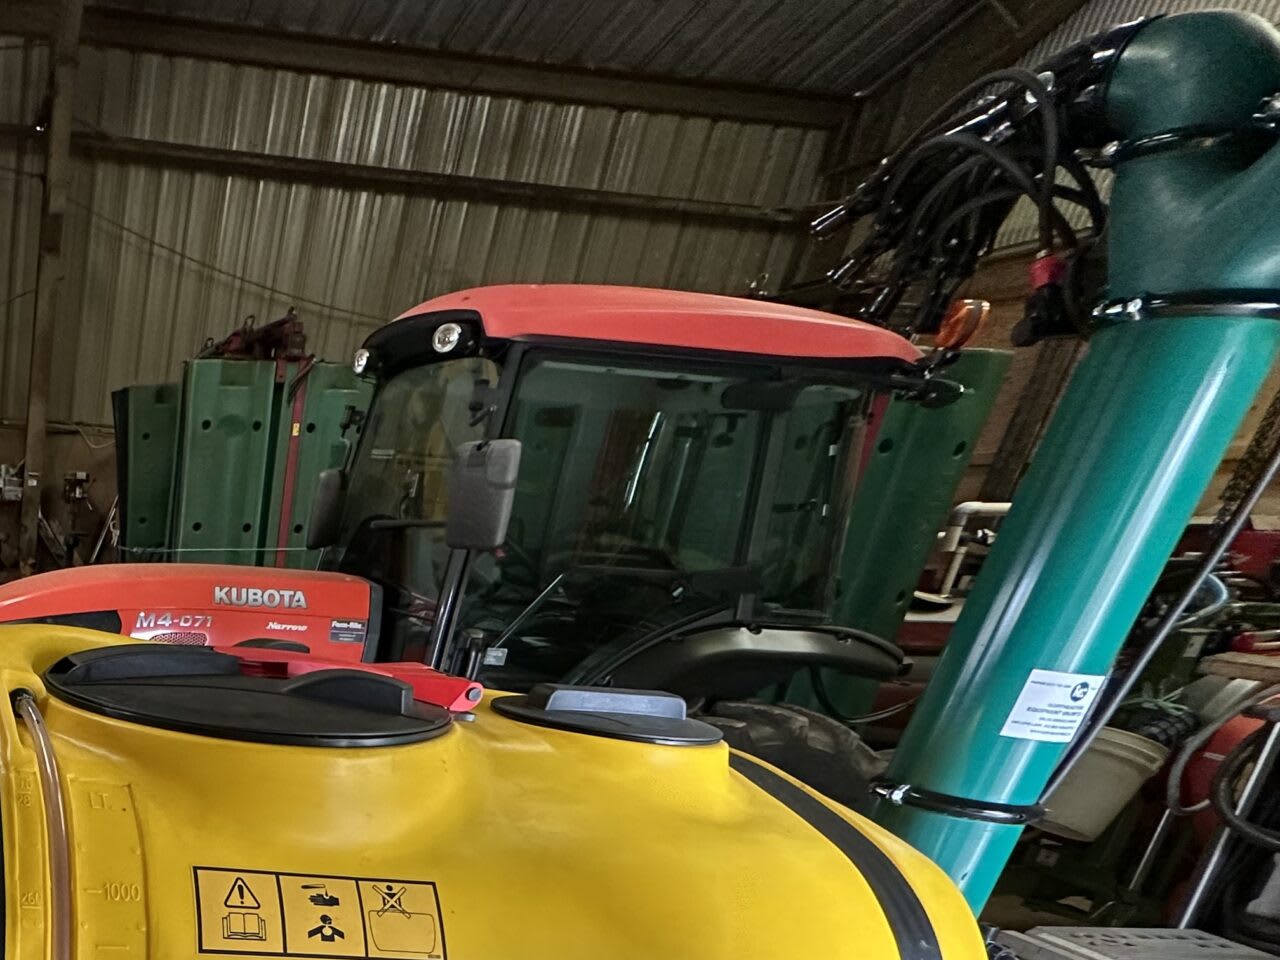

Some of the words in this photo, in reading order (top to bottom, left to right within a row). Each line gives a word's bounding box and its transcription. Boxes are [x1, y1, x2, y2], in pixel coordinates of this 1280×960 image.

[214, 585, 308, 609] KUBOTA
[266, 620, 308, 632] Narrow
[104, 883, 141, 901] 1000
